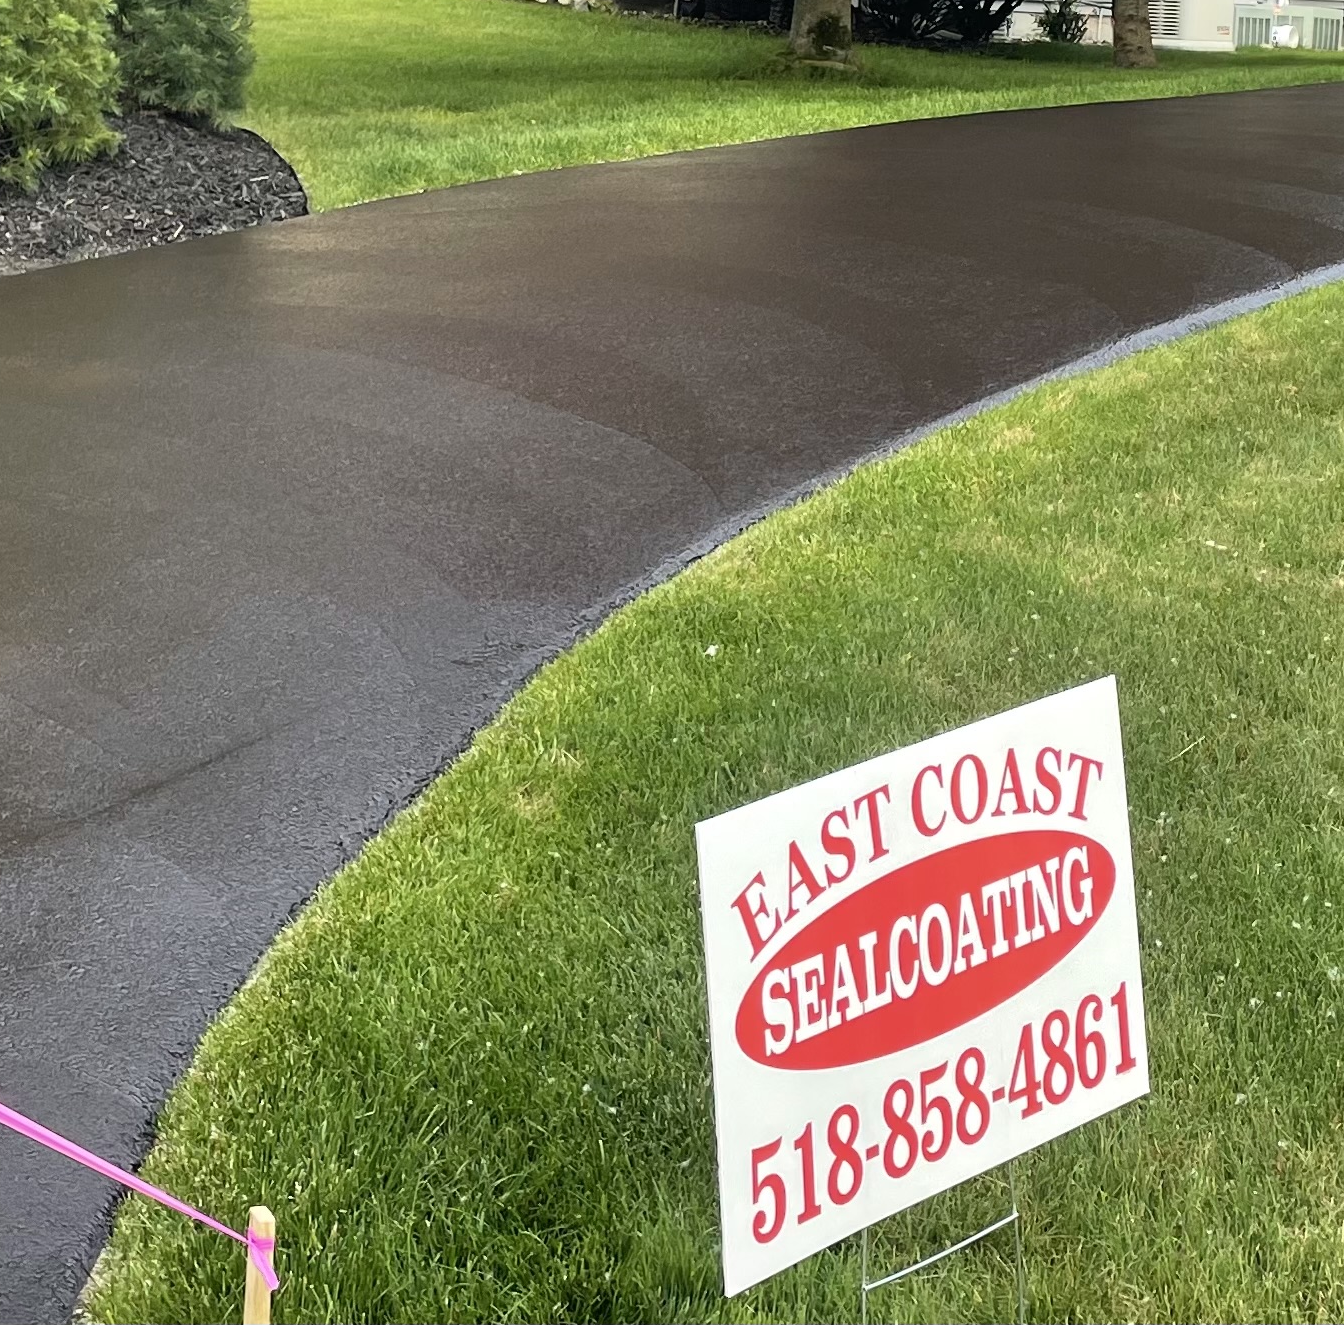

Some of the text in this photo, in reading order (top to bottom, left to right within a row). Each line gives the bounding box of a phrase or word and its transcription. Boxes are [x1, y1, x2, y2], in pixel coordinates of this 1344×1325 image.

[732, 746, 1103, 963] EAST COAST
[761, 845, 1094, 1057] SEALCOATING
[751, 982, 1137, 1244] 518-858-4861
